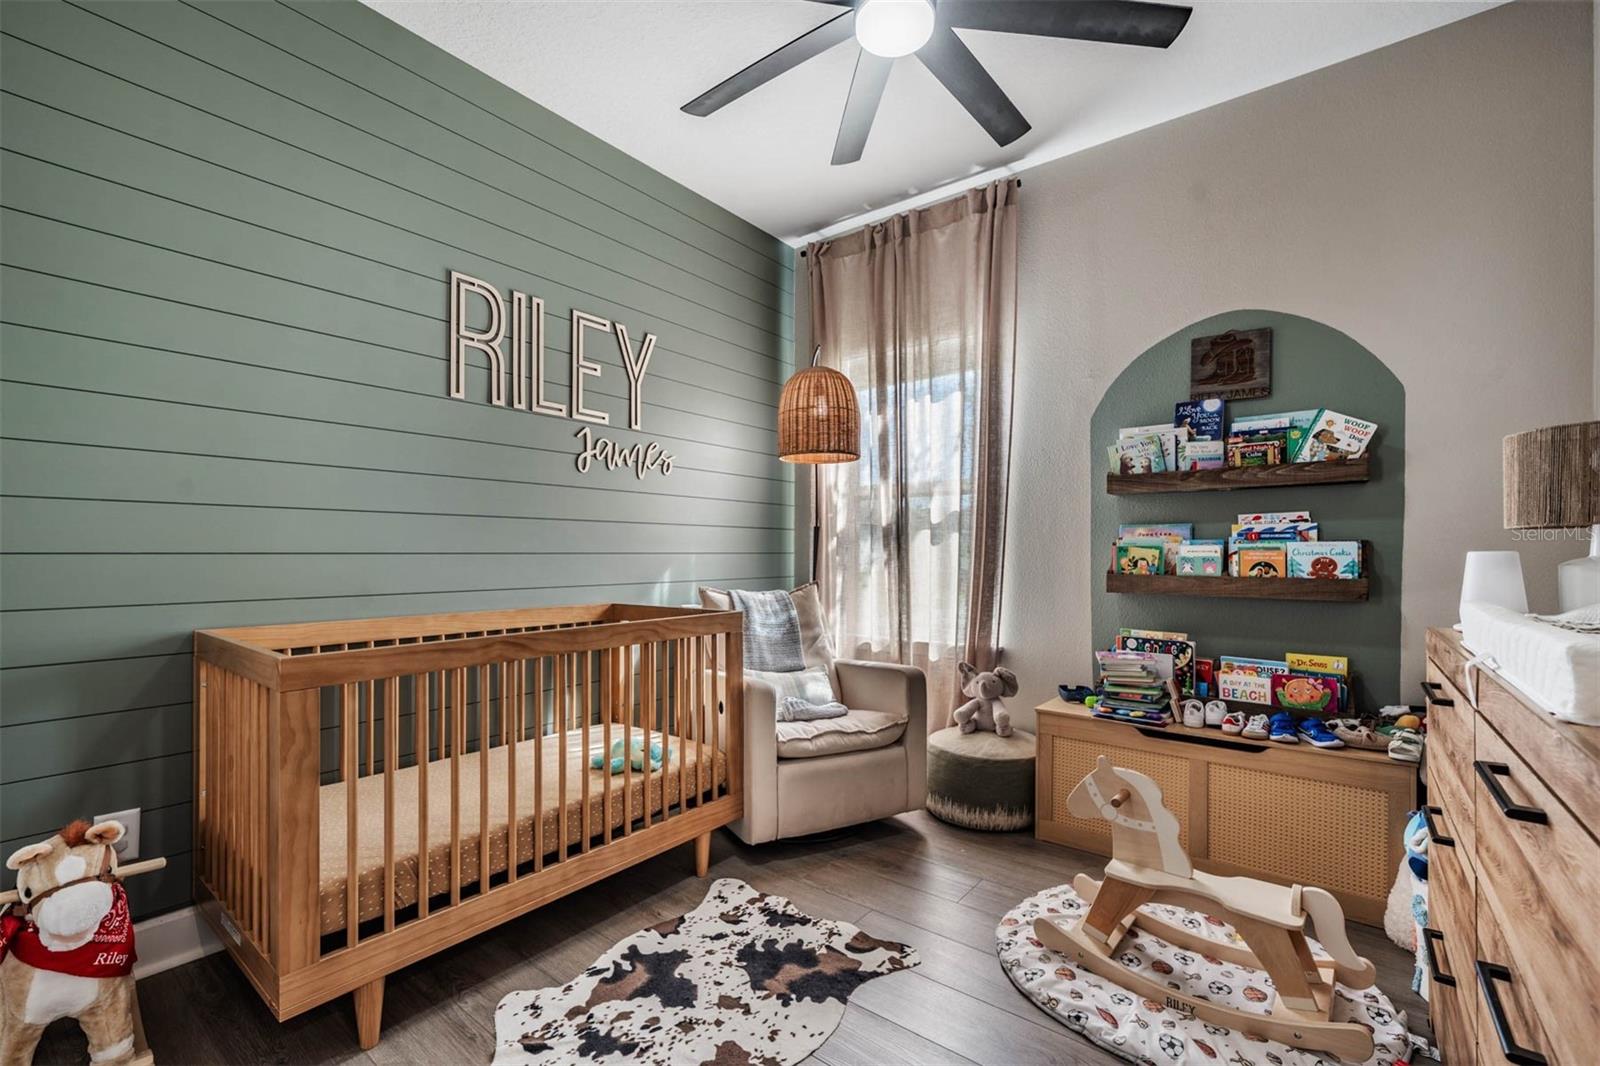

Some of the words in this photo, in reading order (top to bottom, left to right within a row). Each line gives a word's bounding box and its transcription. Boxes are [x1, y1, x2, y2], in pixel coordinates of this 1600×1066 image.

[450, 270, 657, 430] RILEY
[1226, 387, 1270, 400] JAMES
[1182, 404, 1201, 415] Love
[1192, 412, 1209, 423] You
[1343, 418, 1371, 430] WOOF
[1343, 425, 1371, 438] WOOF
[1348, 434, 1365, 444] Dog
[575, 426, 677, 480] James
[1121, 443, 1138, 452] Love
[1292, 547, 1328, 557] Christmas
[1329, 547, 1352, 557] Cookie
[1296, 659, 1308, 667] Dr.
[1308, 659, 1328, 669] Seuss
[1254, 681, 1266, 689] THE
[1222, 687, 1267, 703] BEACH
[92, 951, 129, 967] Riley
[1166, 996, 1196, 1015] RILEY
